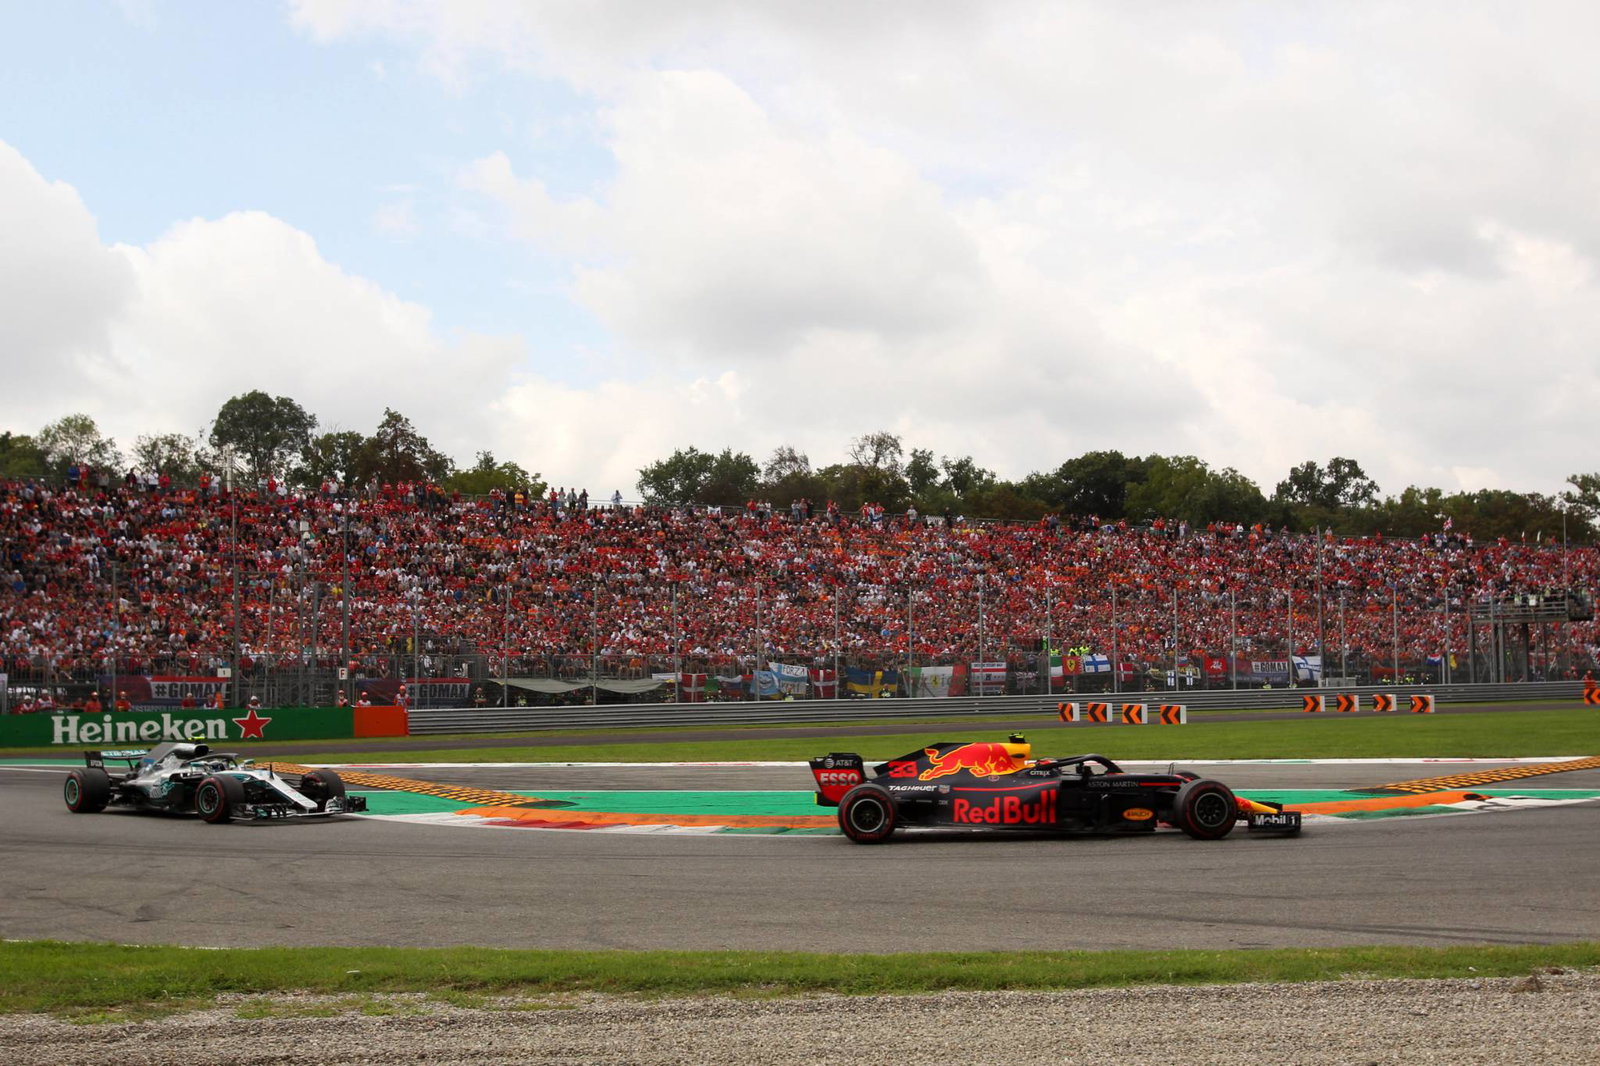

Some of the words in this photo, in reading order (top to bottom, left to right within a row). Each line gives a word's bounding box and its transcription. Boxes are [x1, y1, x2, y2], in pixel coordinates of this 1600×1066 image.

[1255, 661, 1287, 672] #GOMAX
[340, 669, 346, 678] F
[51, 713, 228, 744] Heineken
[835, 759, 853, 767] AT&T
[819, 772, 859, 786] ESSO
[1112, 780, 1139, 788] MARTIN
[953, 797, 1000, 823] Red
[1003, 789, 1056, 823] Bull
[1255, 814, 1287, 825] Mobil
